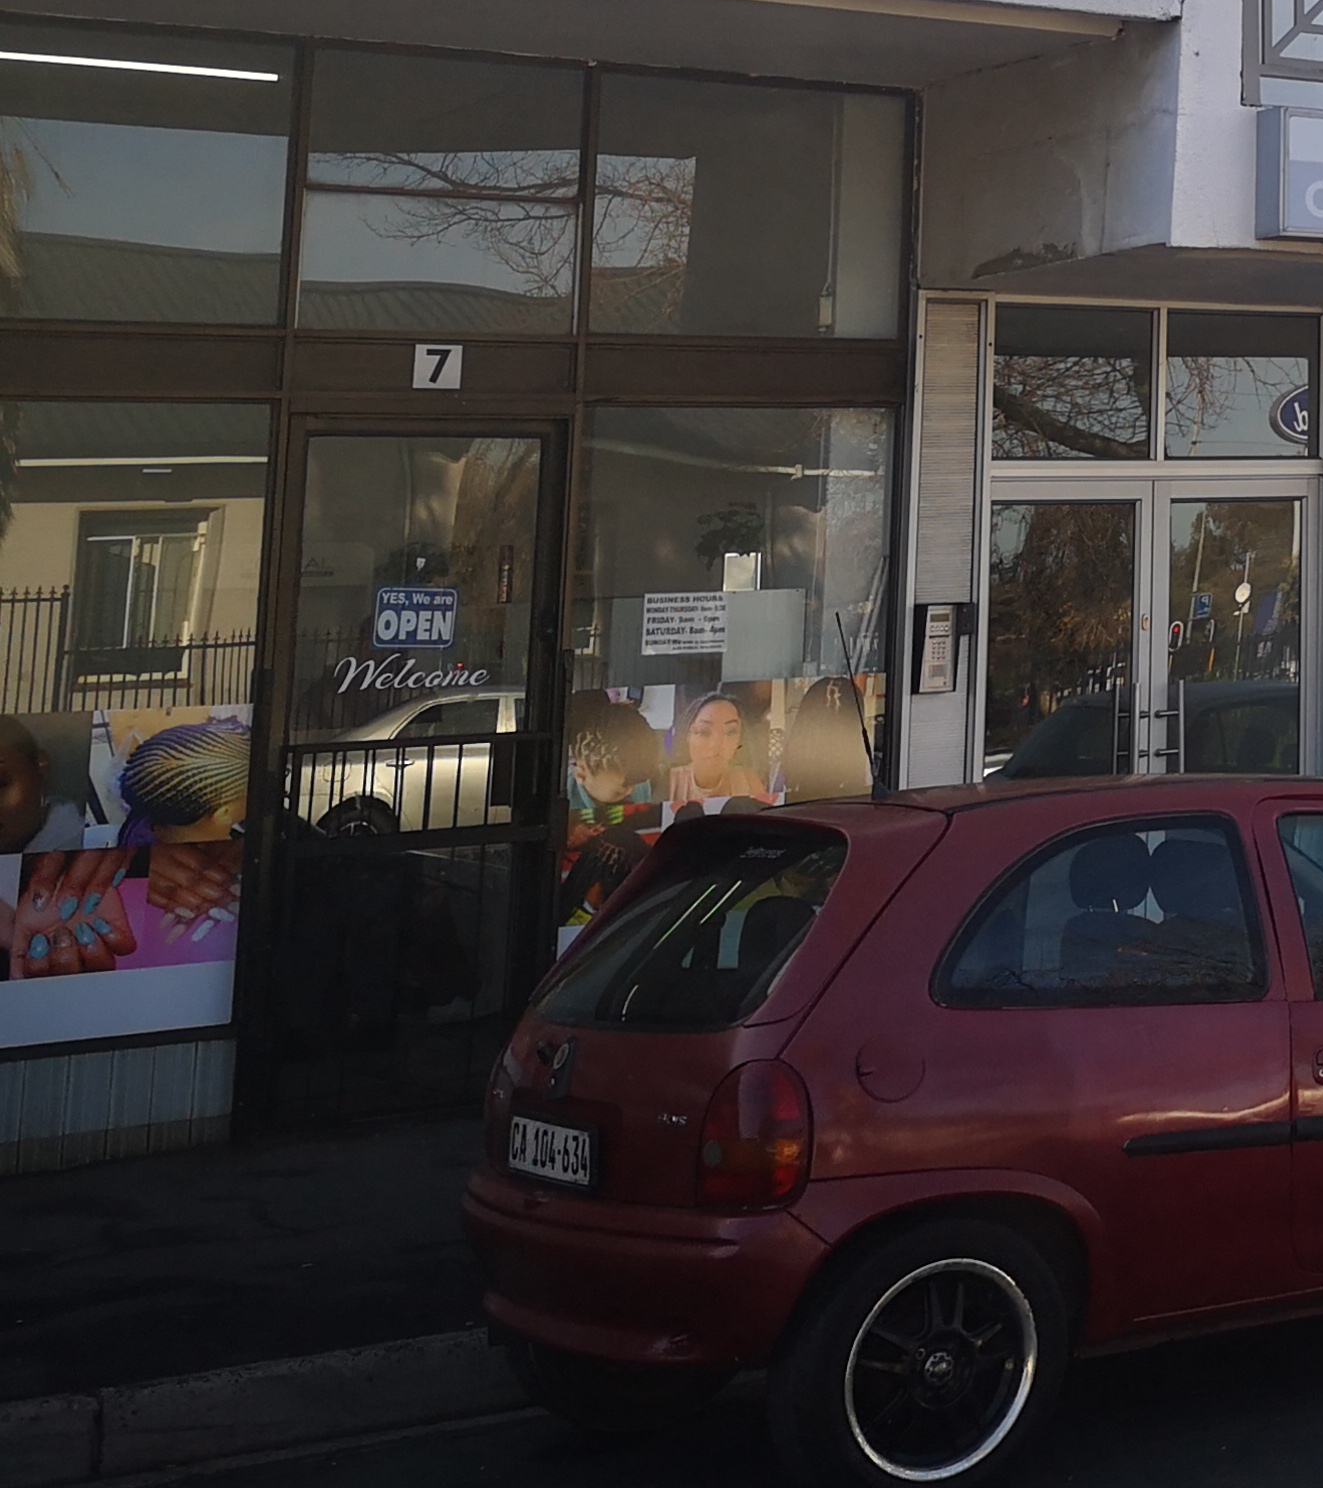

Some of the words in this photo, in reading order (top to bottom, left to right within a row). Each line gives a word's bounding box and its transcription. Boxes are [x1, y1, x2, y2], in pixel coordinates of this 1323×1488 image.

[426, 348, 452, 384] 7
[382, 593, 409, 606] YES,
[412, 593, 430, 604] We
[433, 595, 453, 605] are
[647, 596, 690, 604] BUSINESS
[693, 595, 723, 603] HOURS
[377, 610, 452, 641] OPEN
[334, 653, 490, 694] Welcome
[512, 1122, 526, 1163] CA
